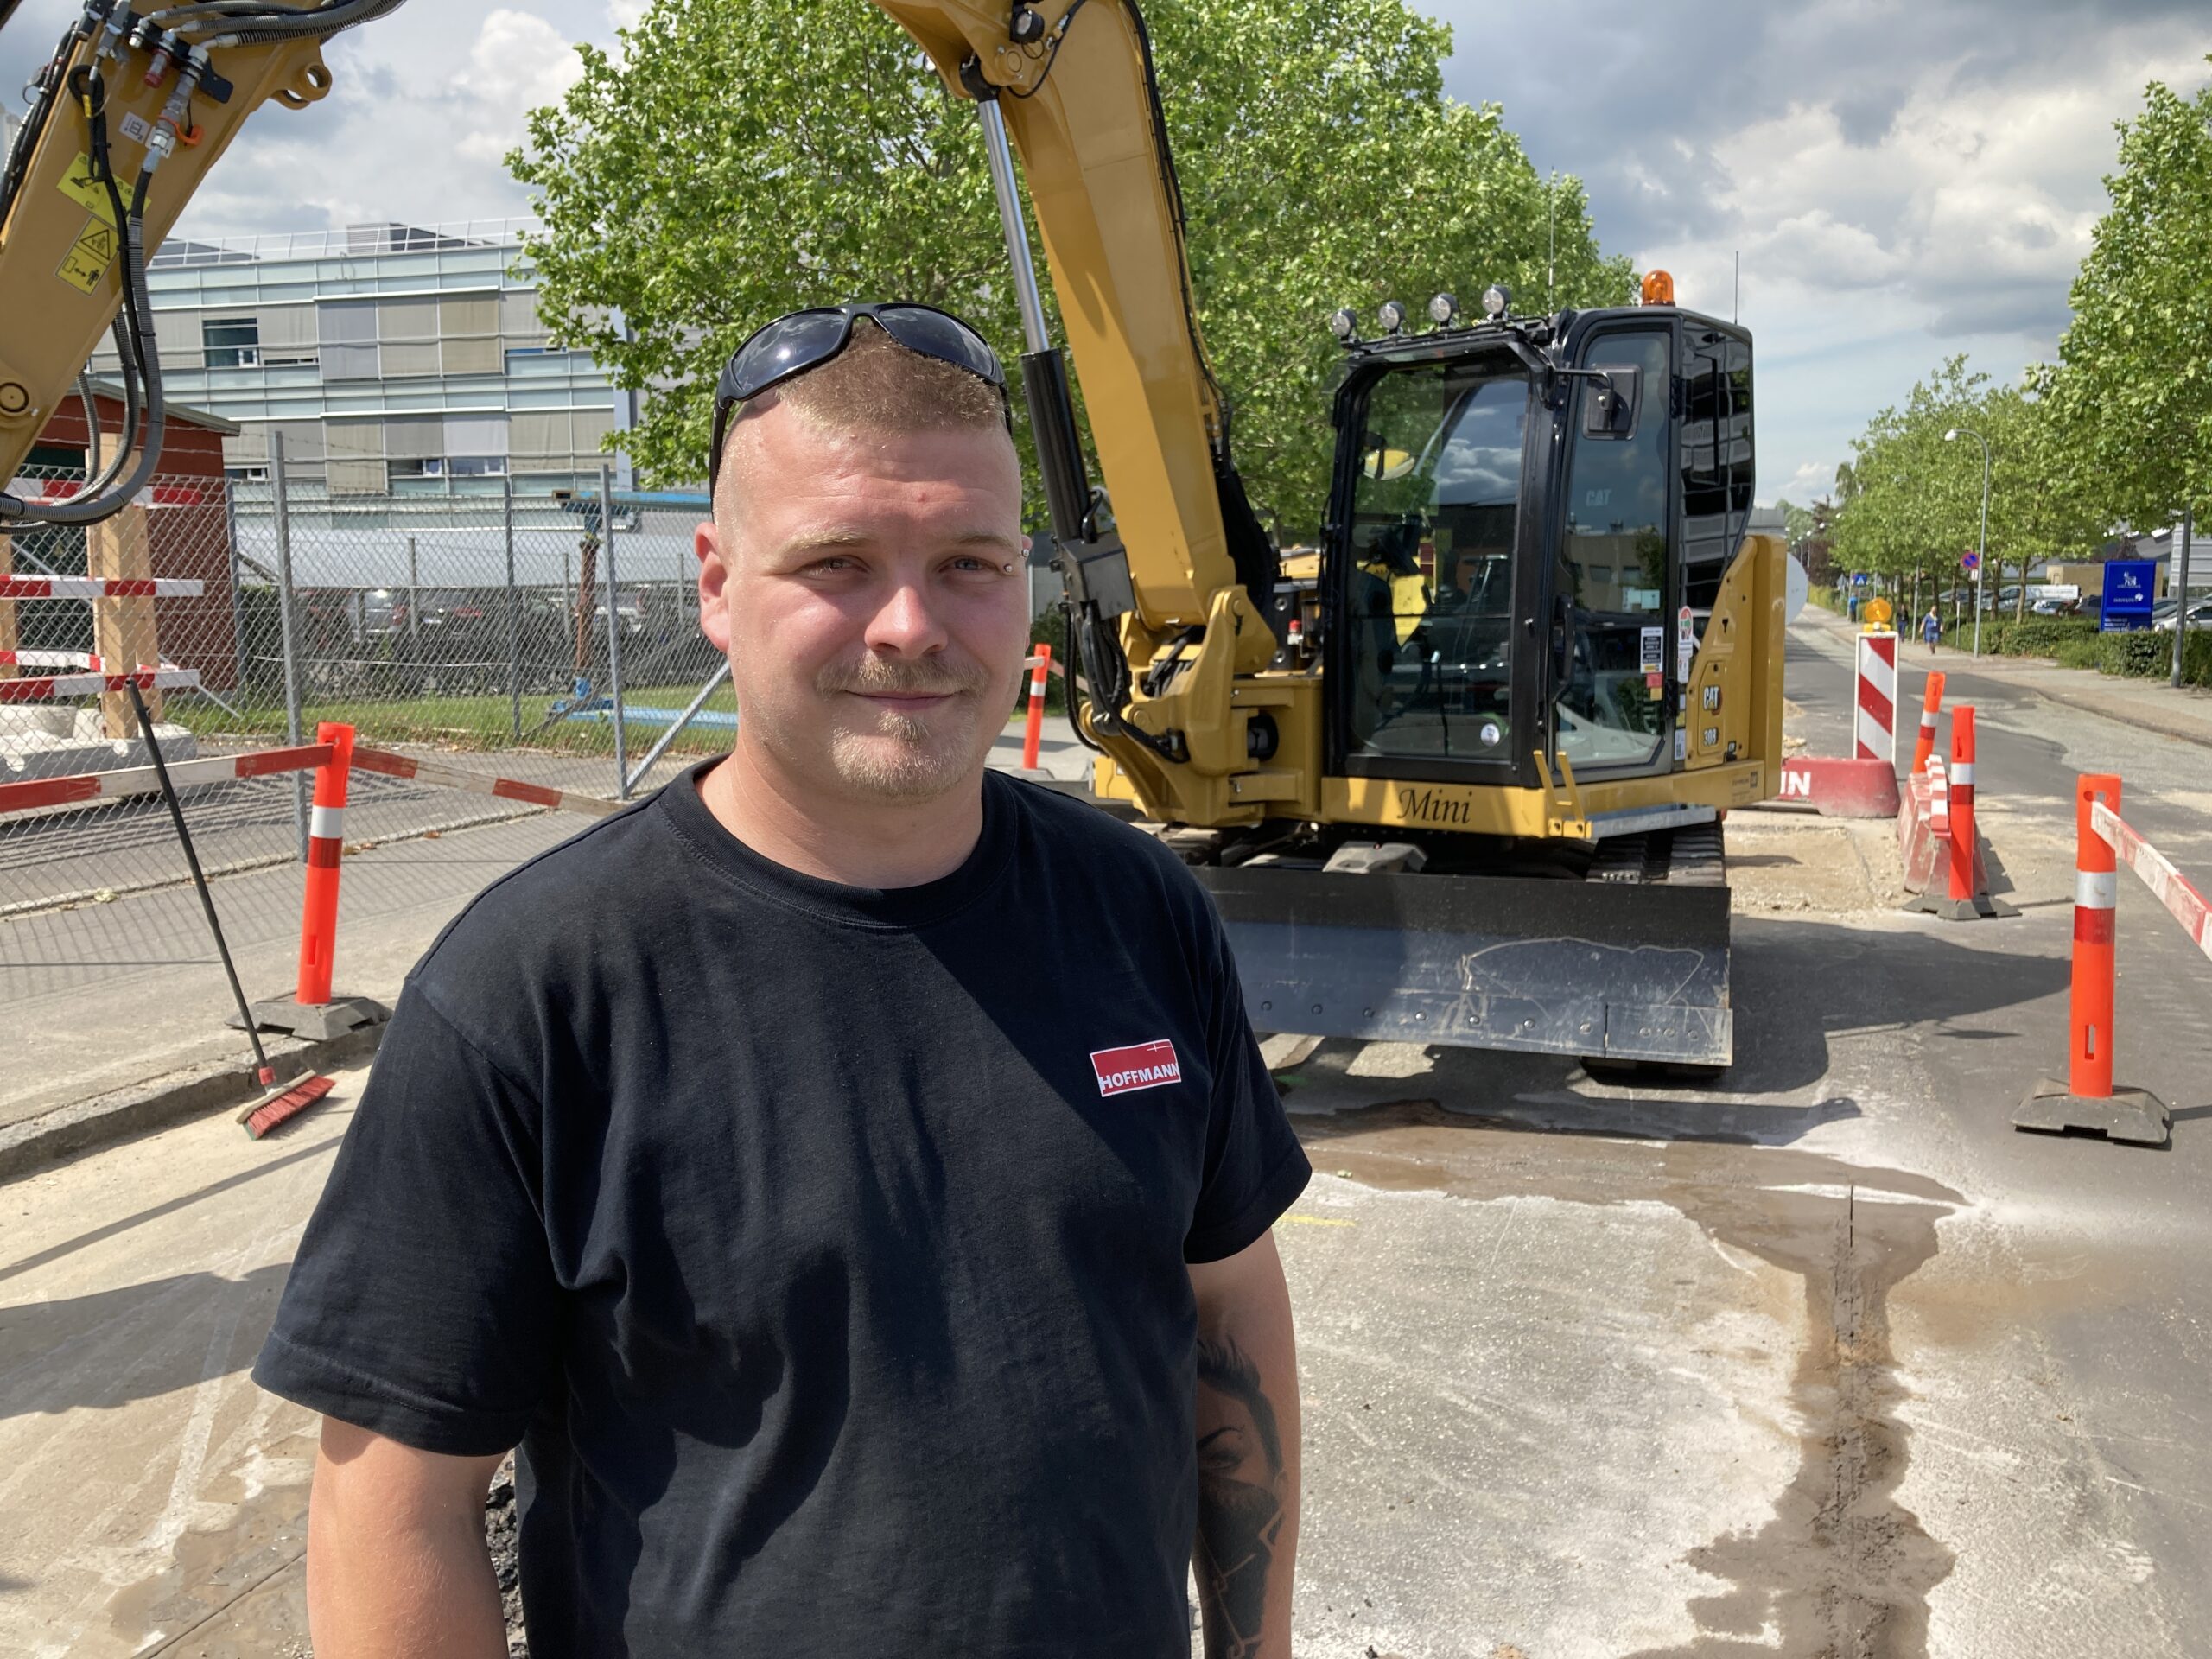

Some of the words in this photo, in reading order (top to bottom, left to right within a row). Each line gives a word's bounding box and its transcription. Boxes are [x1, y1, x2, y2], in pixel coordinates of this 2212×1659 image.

[1586, 489, 1611, 507] CAT
[1703, 686, 1719, 710] CAT
[1703, 728, 1718, 747] 308
[1396, 788, 1473, 824] Mini
[1099, 1063, 1180, 1090] HOFFMANN
